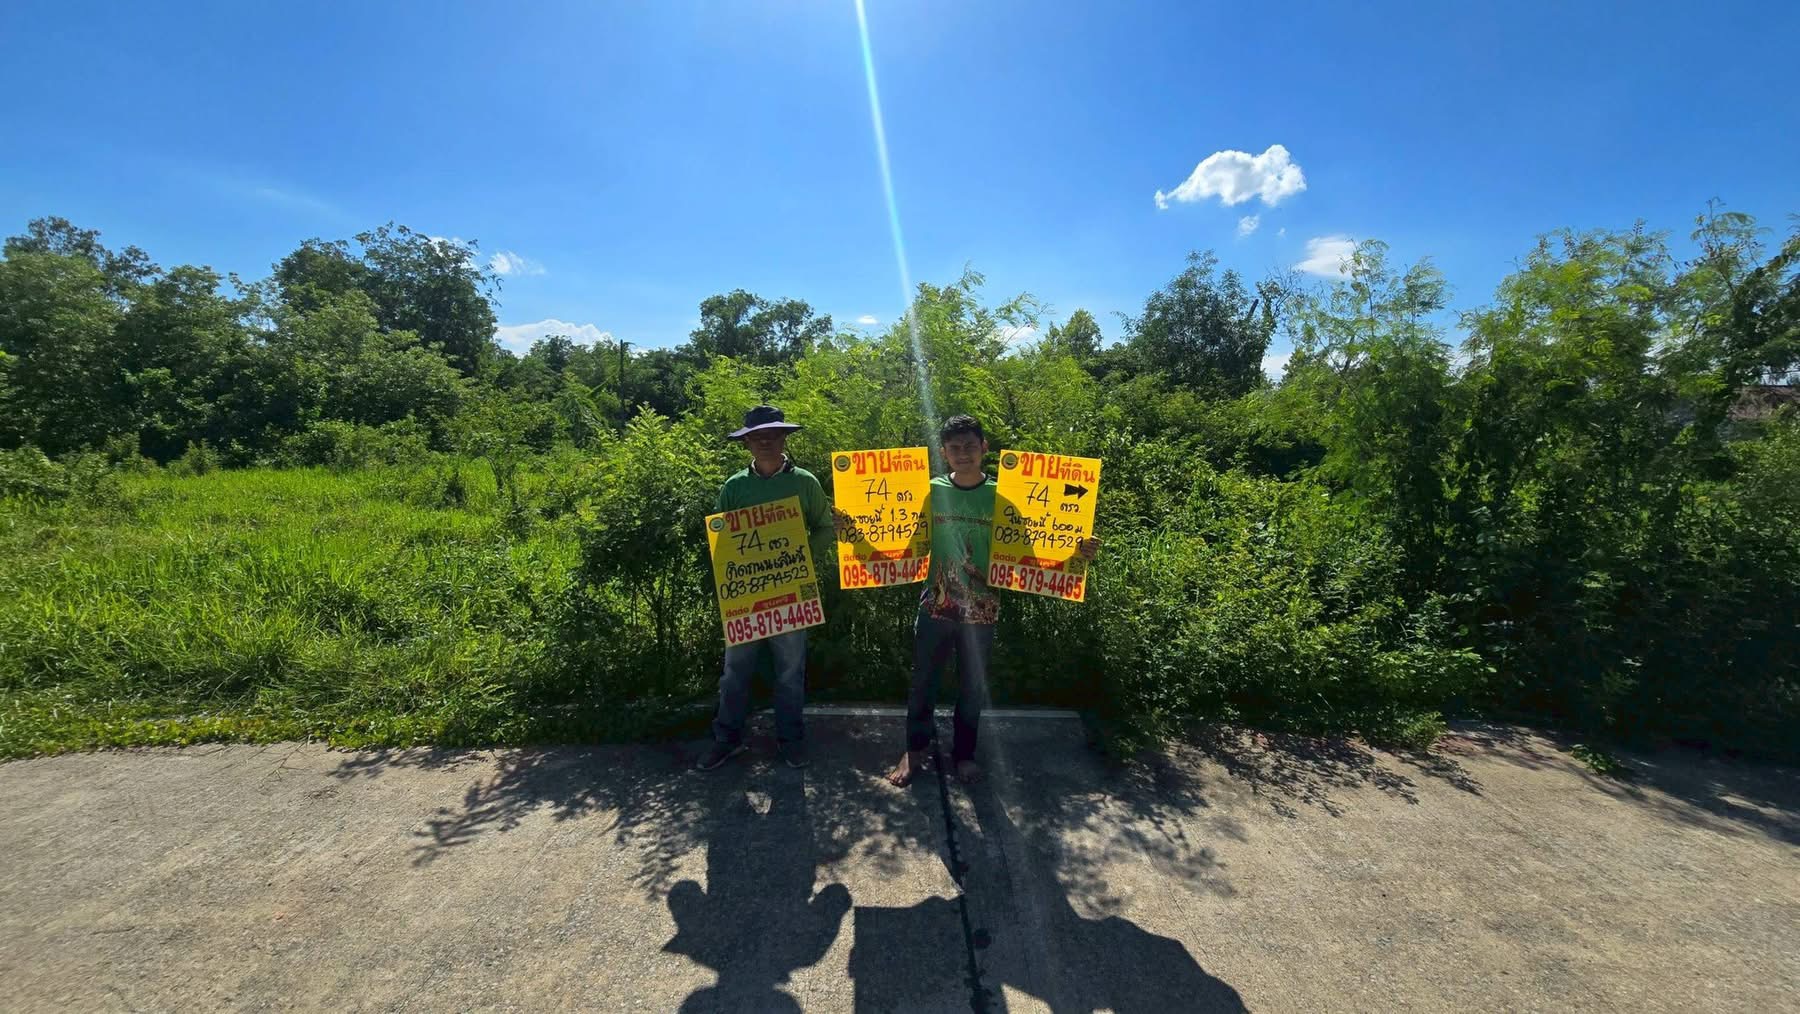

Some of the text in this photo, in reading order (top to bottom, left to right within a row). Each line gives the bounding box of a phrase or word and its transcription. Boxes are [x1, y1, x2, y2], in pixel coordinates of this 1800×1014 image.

[861, 478, 893, 503] 74
[1024, 481, 1051, 508] 74
[731, 529, 766, 556] 74
[840, 520, 929, 543] 083-8794529
[994, 525, 1084, 549] 083-8794529
[720, 565, 810, 600] 083-8794529
[843, 557, 929, 587] 095-879-4465
[990, 562, 1083, 600] 095-879-4465
[727, 600, 823, 644] 095-879-4465
